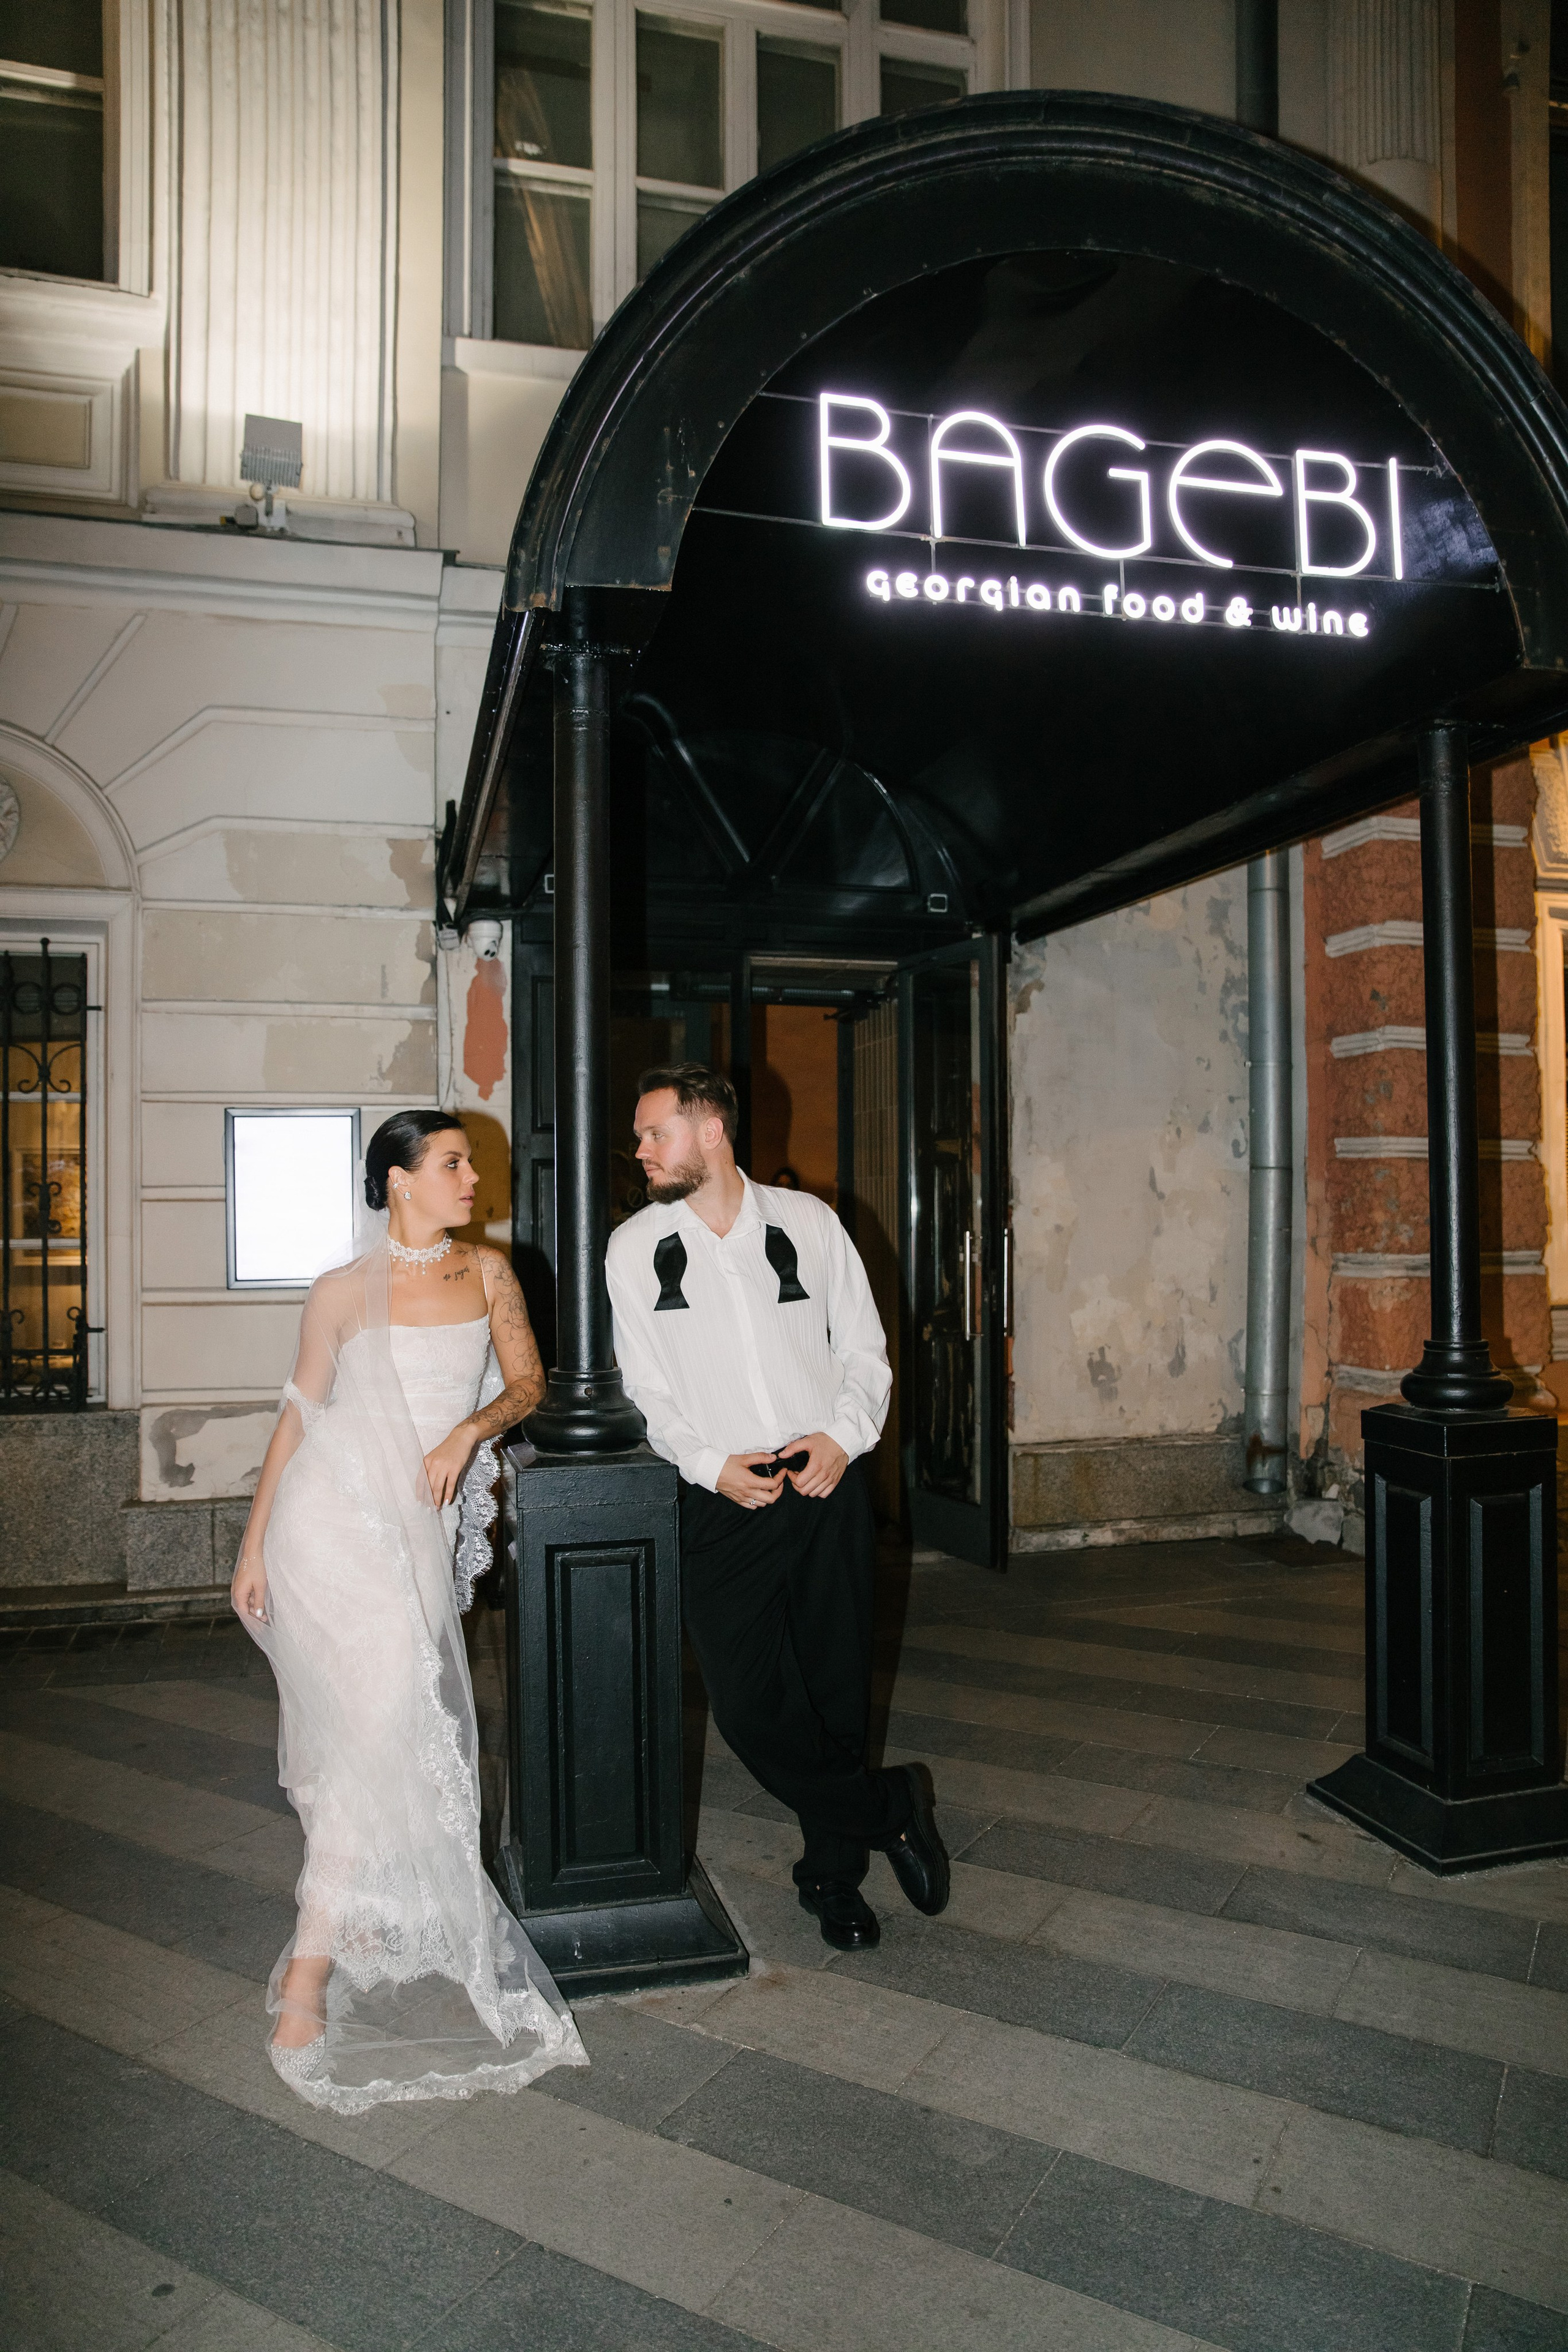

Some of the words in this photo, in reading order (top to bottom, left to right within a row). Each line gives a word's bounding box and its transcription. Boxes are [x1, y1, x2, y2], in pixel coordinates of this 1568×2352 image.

[866, 570, 1081, 612] georgian
[1103, 584, 1205, 623] food
[1225, 597, 1253, 627] &
[1272, 603, 1368, 637] wine
